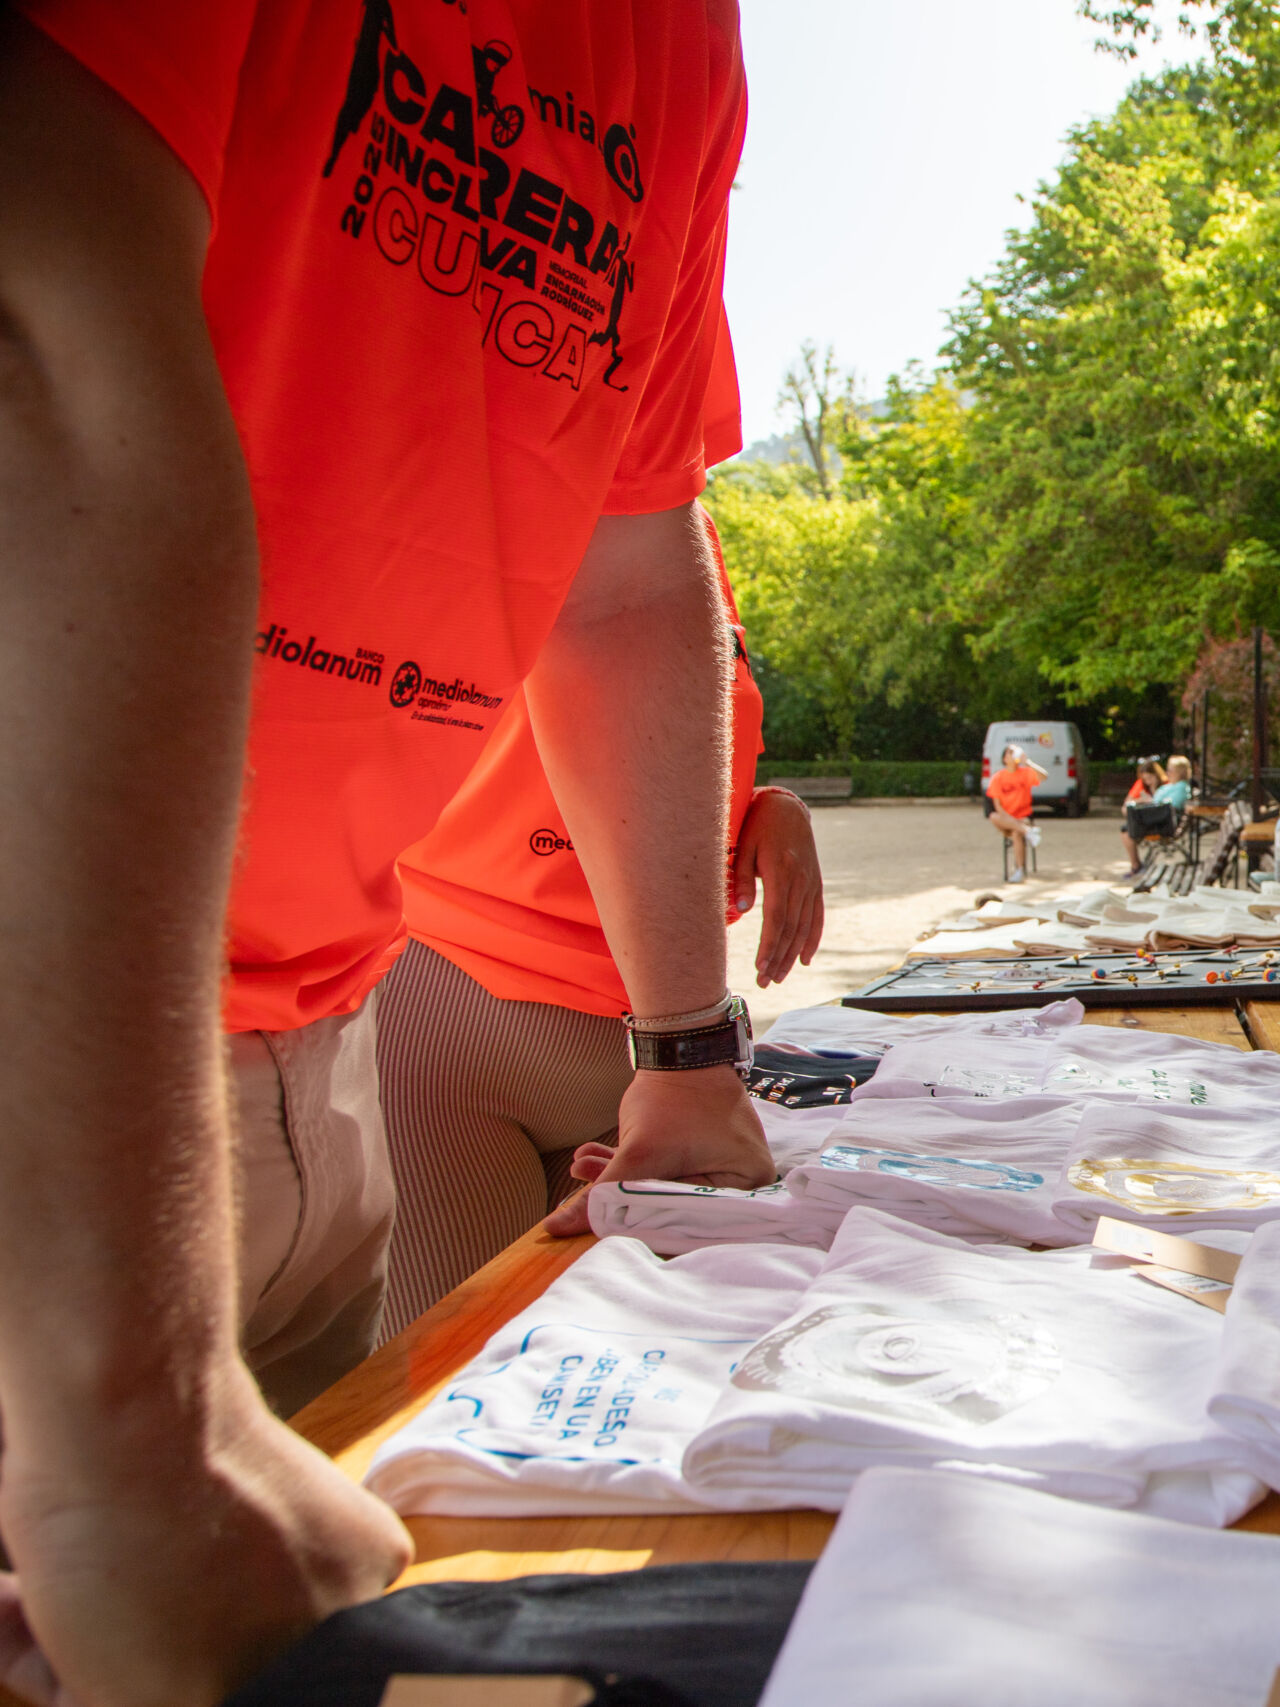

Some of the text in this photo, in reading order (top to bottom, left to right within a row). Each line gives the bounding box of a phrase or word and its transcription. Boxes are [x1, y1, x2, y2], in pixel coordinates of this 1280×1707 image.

[341, 110, 386, 239] 2025
[548, 259, 588, 289] MEMORIAL
[540, 285, 595, 323] RODRÍGUEZ
[254, 624, 382, 687] diolanum
[355, 647, 385, 665] BANCO
[422, 677, 504, 709] mediolanum
